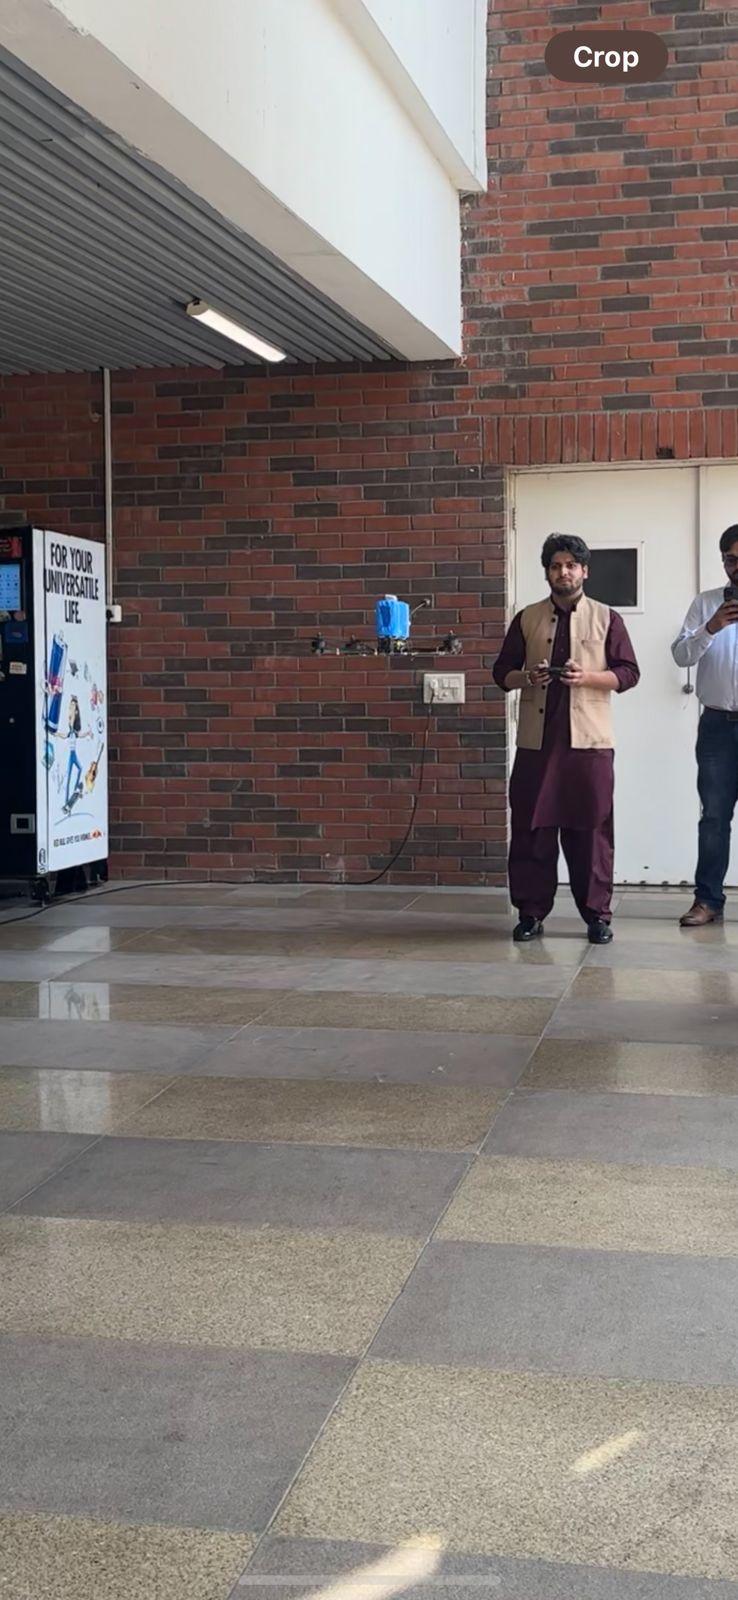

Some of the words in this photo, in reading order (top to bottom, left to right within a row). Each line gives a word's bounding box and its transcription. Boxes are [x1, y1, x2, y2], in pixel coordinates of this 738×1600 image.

[50, 542, 68, 569] FOR
[69, 547, 93, 574] YOUR
[44, 568, 99, 601] UNIVERSATILE
[64, 599, 82, 624] LIFE.
